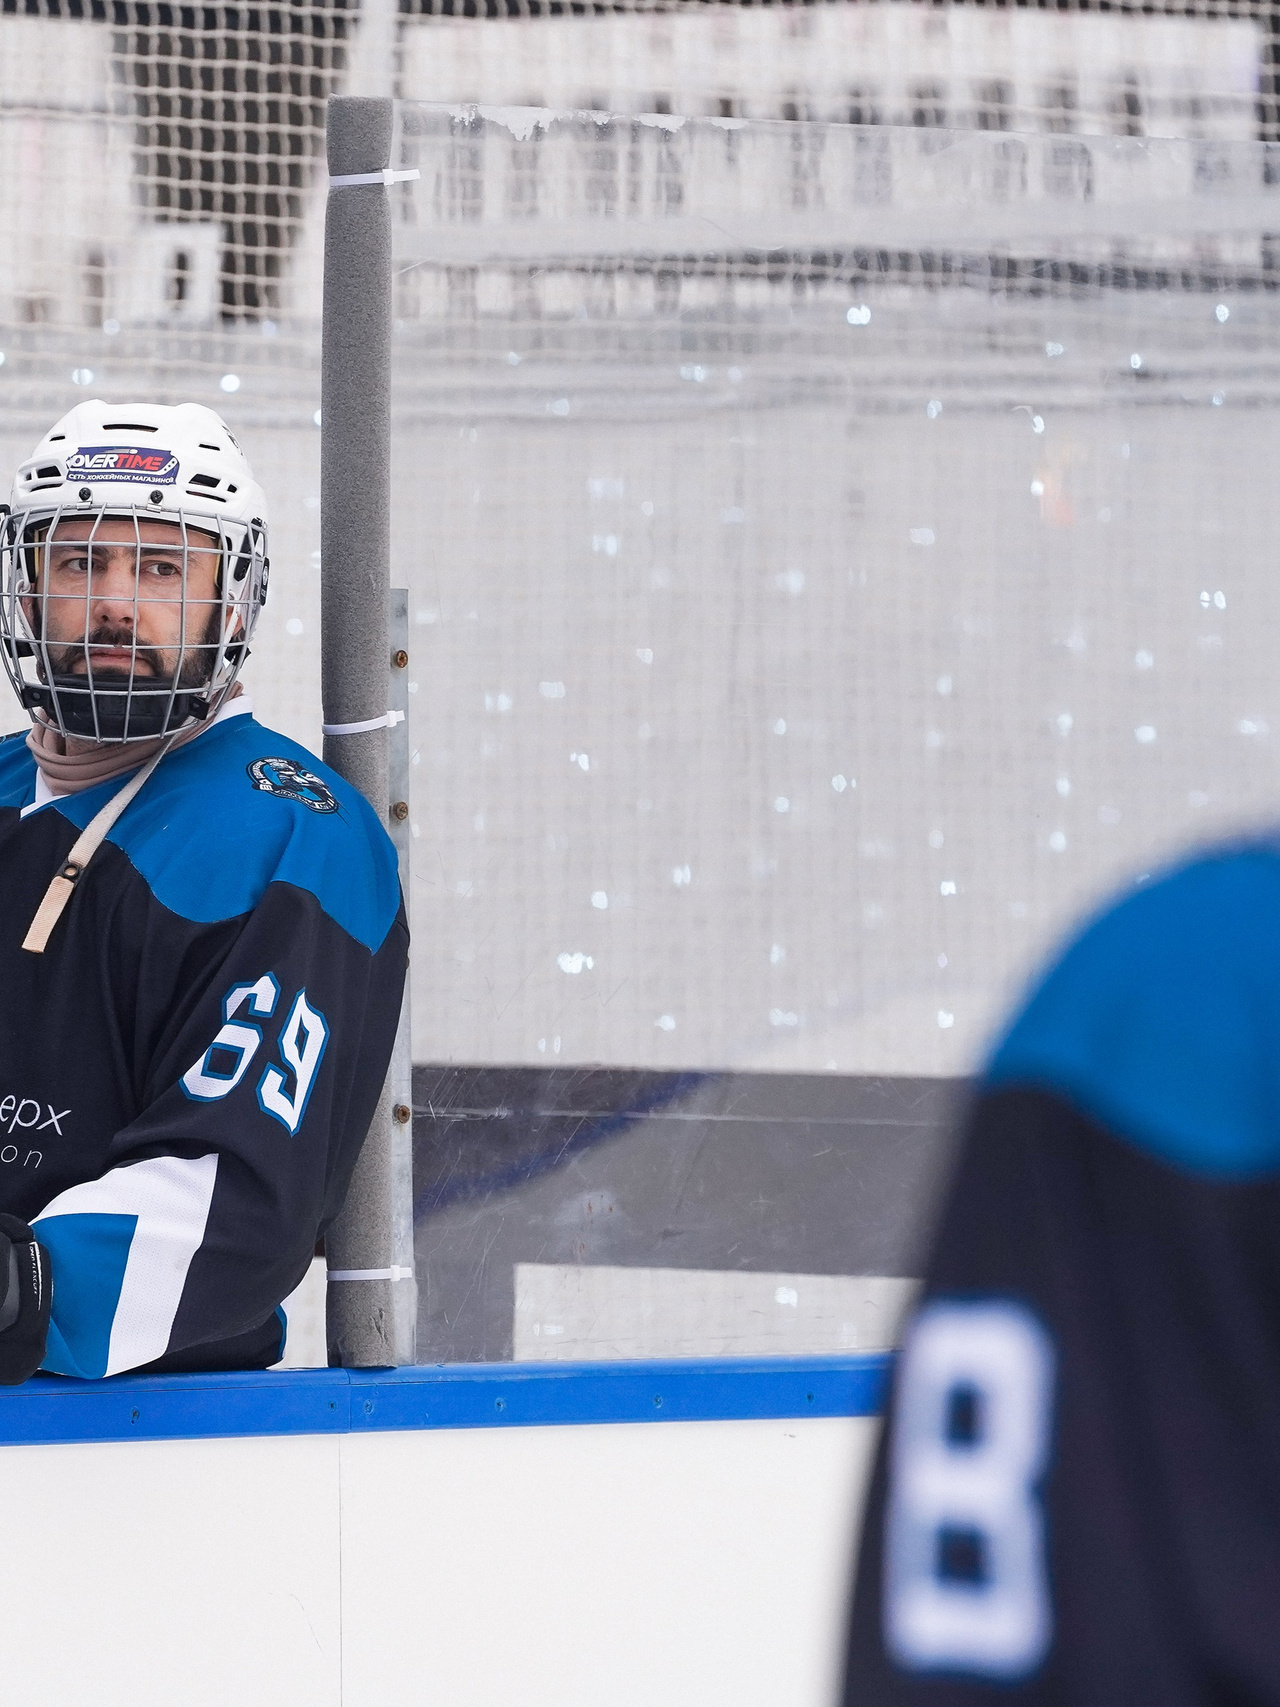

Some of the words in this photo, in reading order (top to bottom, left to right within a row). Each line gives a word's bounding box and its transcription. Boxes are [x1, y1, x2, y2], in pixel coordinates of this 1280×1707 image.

[71, 453, 164, 471] OVERTIME
[86, 473, 132, 481] ХОККЕЙНЫХ
[180, 972, 329, 1136] 69
